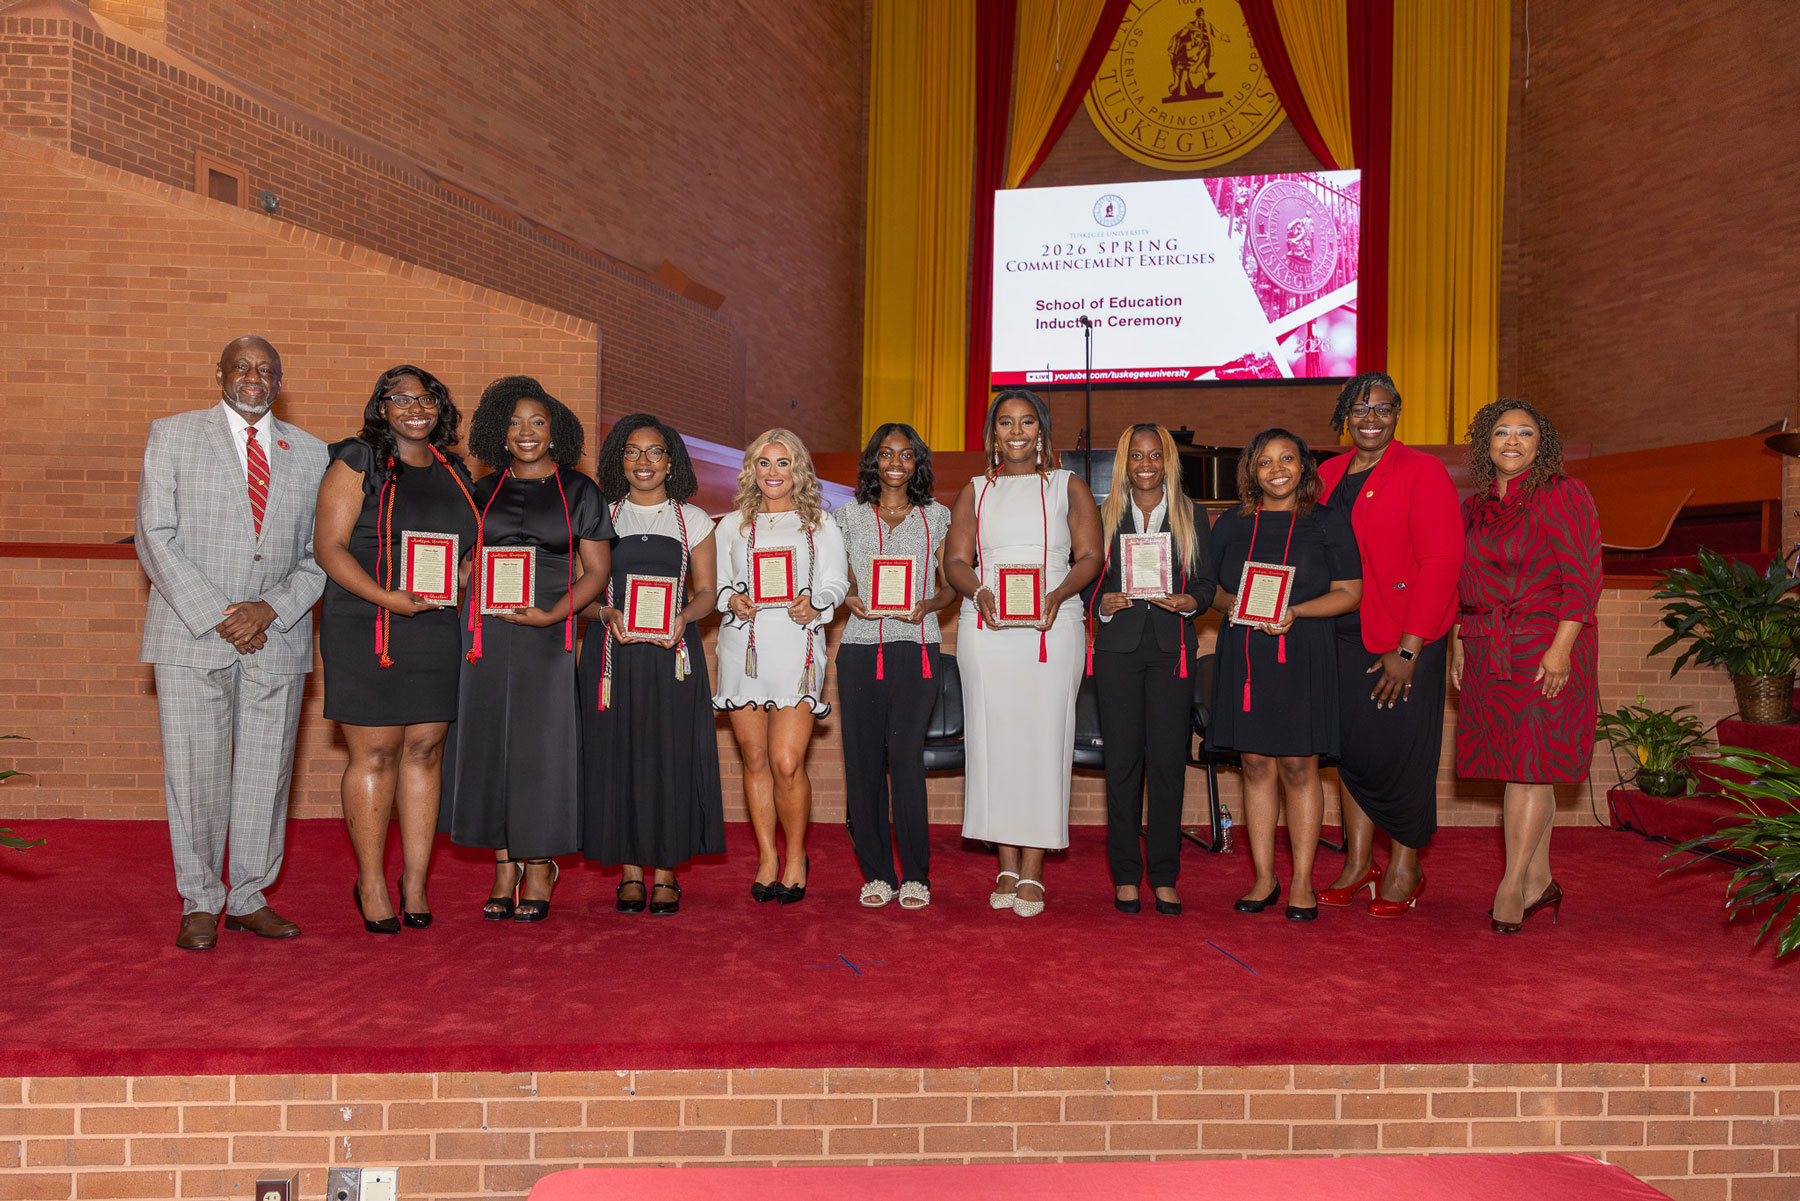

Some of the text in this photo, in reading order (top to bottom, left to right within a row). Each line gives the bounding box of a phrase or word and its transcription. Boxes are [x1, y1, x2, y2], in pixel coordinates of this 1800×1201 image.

[1124, 27, 1145, 105] SCIENTIA
[1148, 81, 1252, 126] PRINCIPATUS
[1099, 69, 1276, 153] TUSKEGEENS
[1070, 229, 1150, 240] TUSKEGEE UNIVERSITY
[1041, 238, 1178, 257] 2026 SPRING
[1006, 252, 1216, 273] COMMENCEMENT EXERCISES
[1035, 295, 1183, 312] School of Education
[1036, 315, 1183, 330] Inductn Ceremony
[1294, 336, 1332, 354] 2026
[1054, 369, 1190, 381] youtubecom/tuskegeeuniversity
